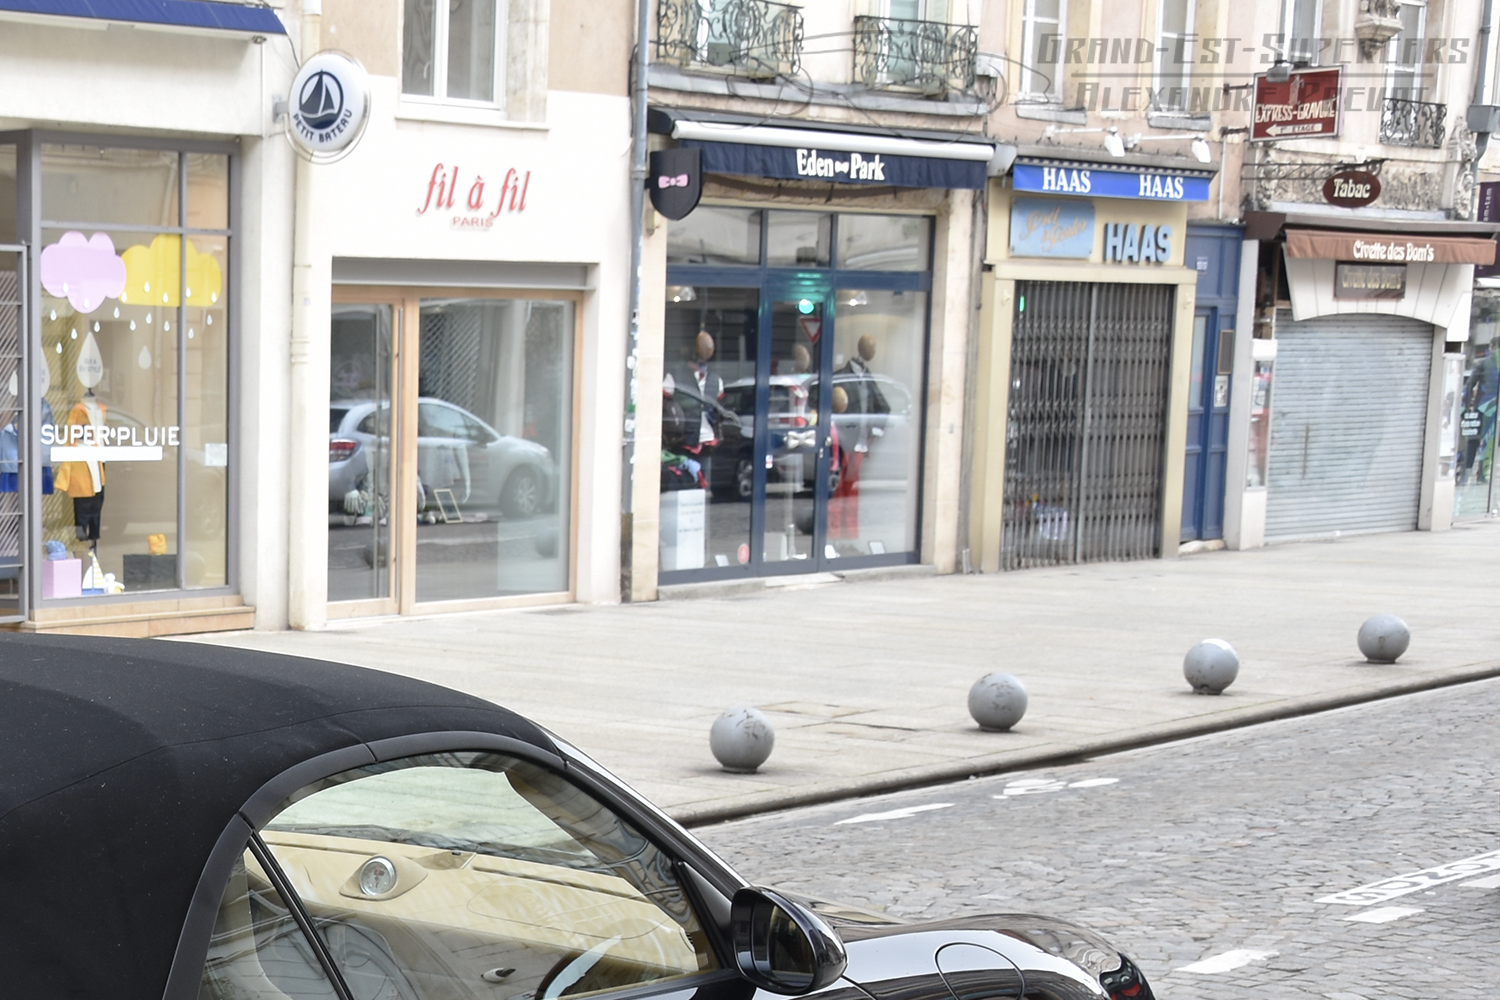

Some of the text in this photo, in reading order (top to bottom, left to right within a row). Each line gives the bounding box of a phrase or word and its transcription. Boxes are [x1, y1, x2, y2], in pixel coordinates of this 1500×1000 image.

[1255, 101, 1336, 123] EXPRESS-GRAVURE
[293, 109, 353, 143] PETIT BATEAU
[796, 149, 885, 180] Eden Park
[416, 162, 531, 218] fil à fil
[1042, 167, 1091, 193] HAAS
[1139, 174, 1184, 199] HAAS
[1333, 178, 1371, 198] Tabac
[452, 216, 494, 228] PARIS
[1105, 223, 1172, 262] HAAS
[1353, 240, 1386, 259] Civette
[1387, 242, 1405, 260] des
[40, 425, 180, 446] SUPER PLUIE
